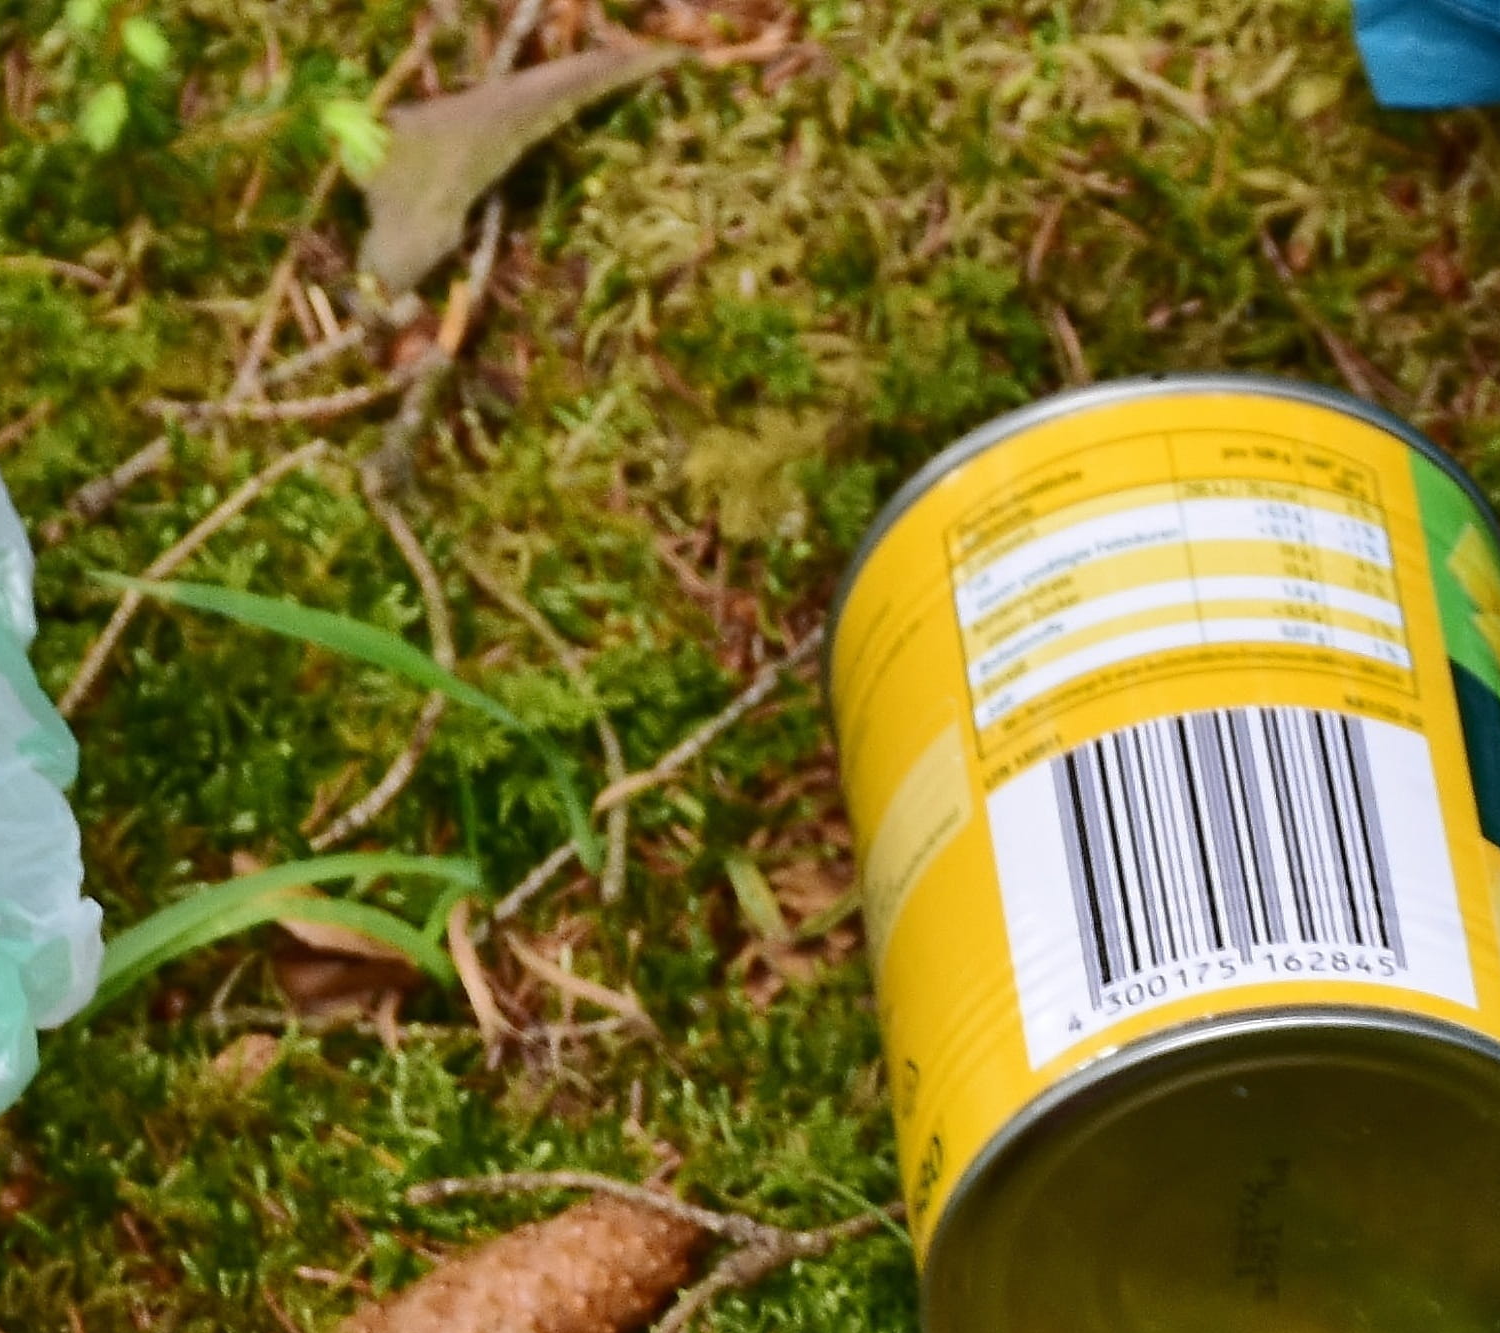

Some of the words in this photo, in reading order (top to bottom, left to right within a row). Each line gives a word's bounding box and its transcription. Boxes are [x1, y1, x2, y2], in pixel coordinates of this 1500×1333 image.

[1066, 1010, 1083, 1032] 4
[1105, 958, 1238, 1014] 300175
[1263, 951, 1396, 976] 162845
